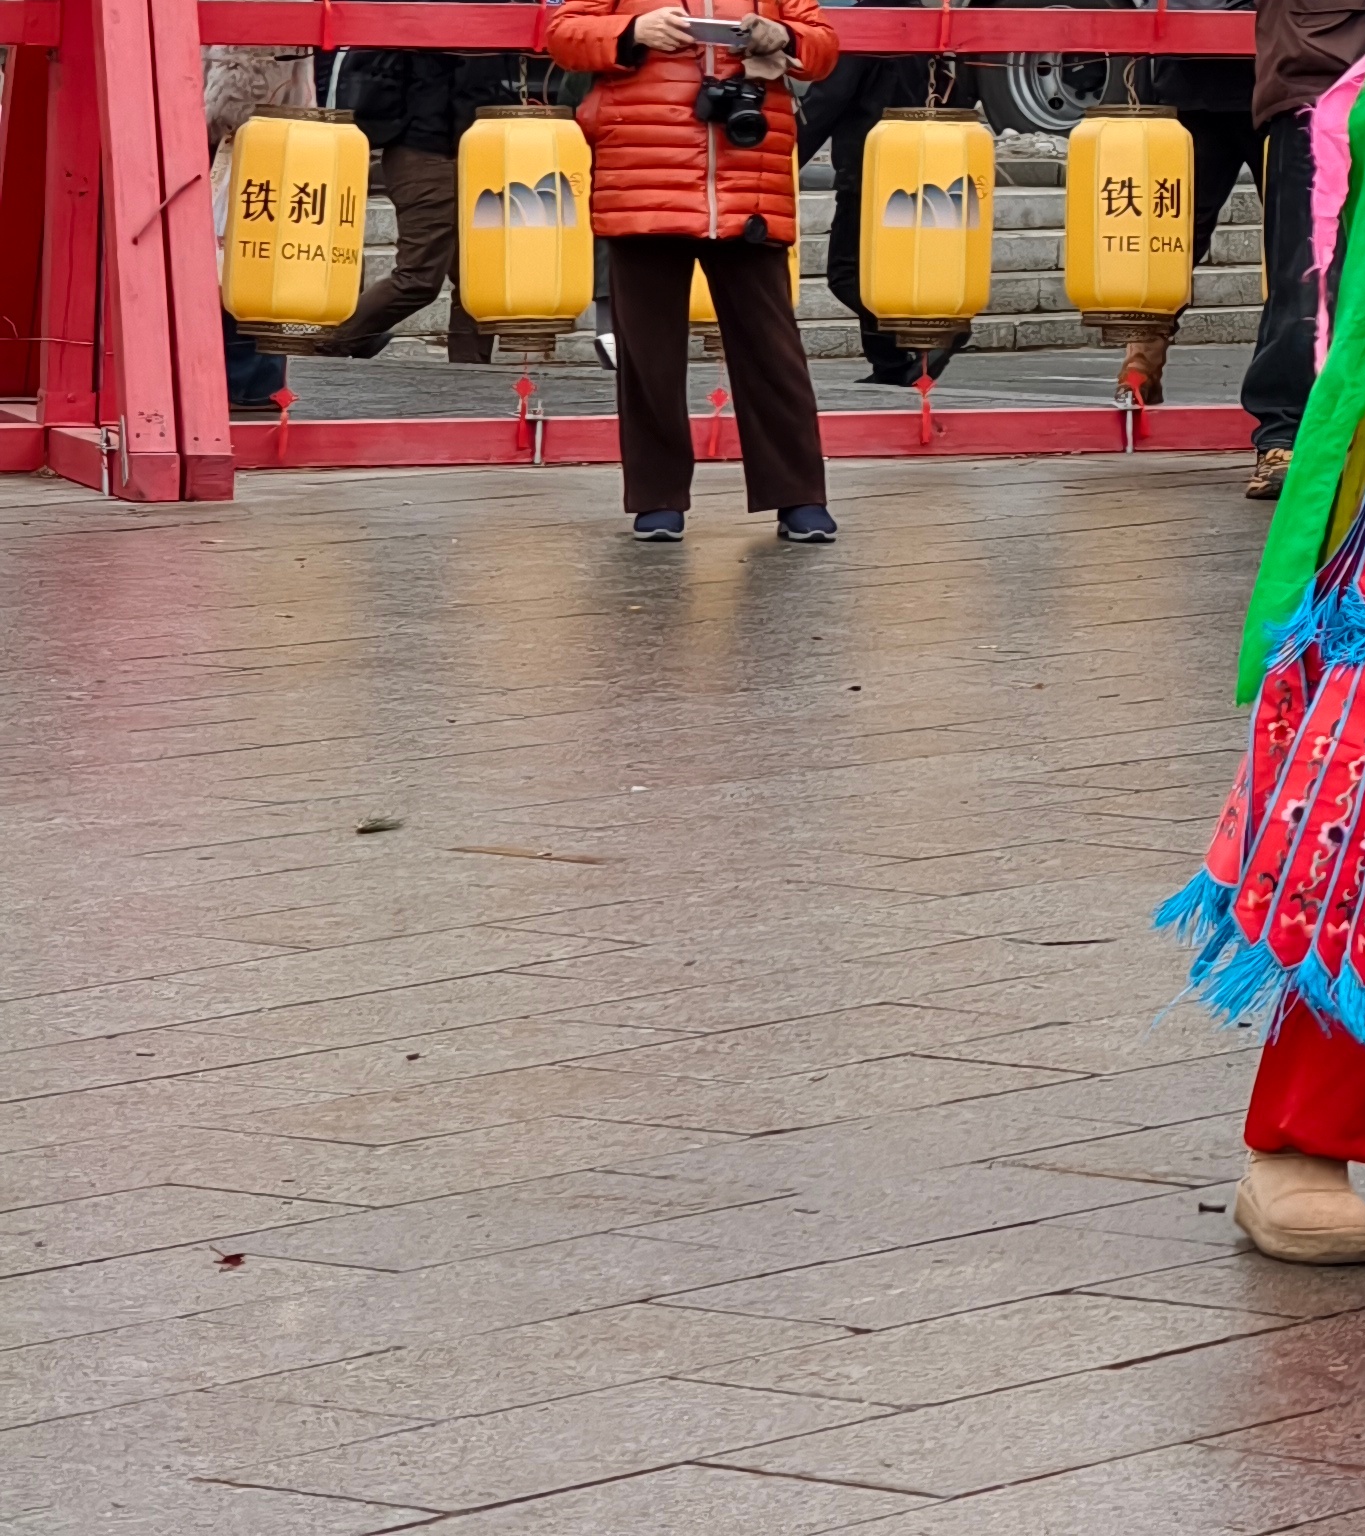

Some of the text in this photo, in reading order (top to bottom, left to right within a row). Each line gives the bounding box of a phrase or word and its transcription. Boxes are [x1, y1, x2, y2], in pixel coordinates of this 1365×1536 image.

[240, 178, 356, 228] 铁刹山
[1100, 176, 1181, 218] 铁刹
[238, 240, 271, 259] TIE
[281, 243, 326, 261] CHA
[1102, 235, 1184, 253] TIE CHA
